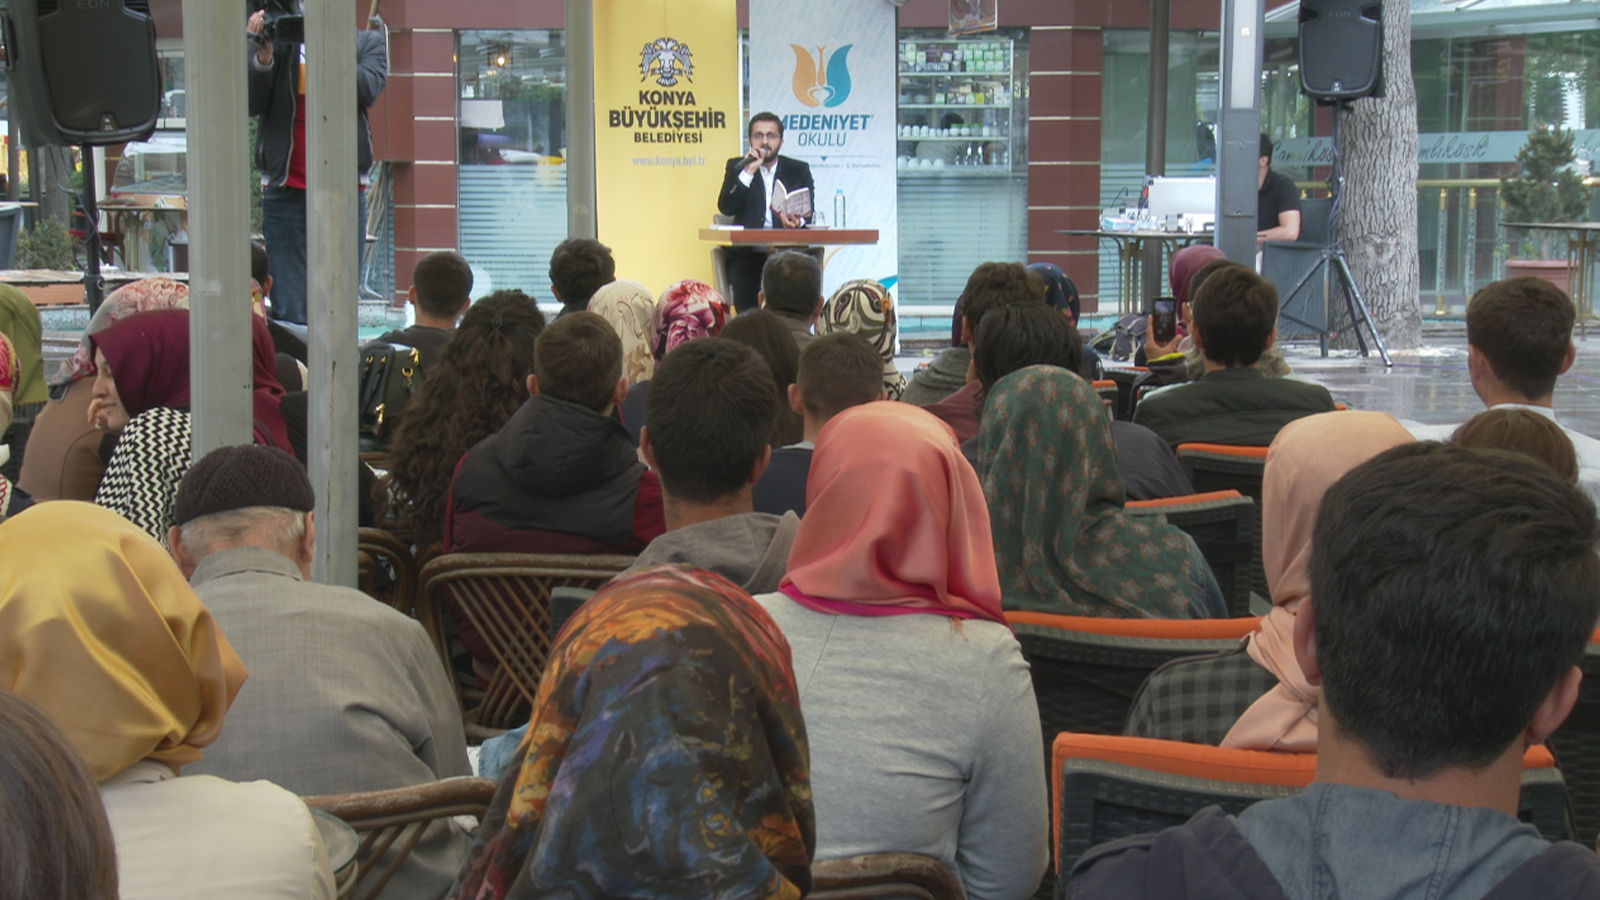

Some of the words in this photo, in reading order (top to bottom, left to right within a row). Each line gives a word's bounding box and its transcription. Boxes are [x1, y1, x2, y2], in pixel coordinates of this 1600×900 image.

[639, 90, 696, 106] KONYA
[608, 106, 726, 131] BÜYÜKŞEHİR
[634, 130, 703, 143] BELEDİYESİ
[798, 132, 847, 147] OKULU
[631, 155, 706, 168] www.konya.bel.tr
